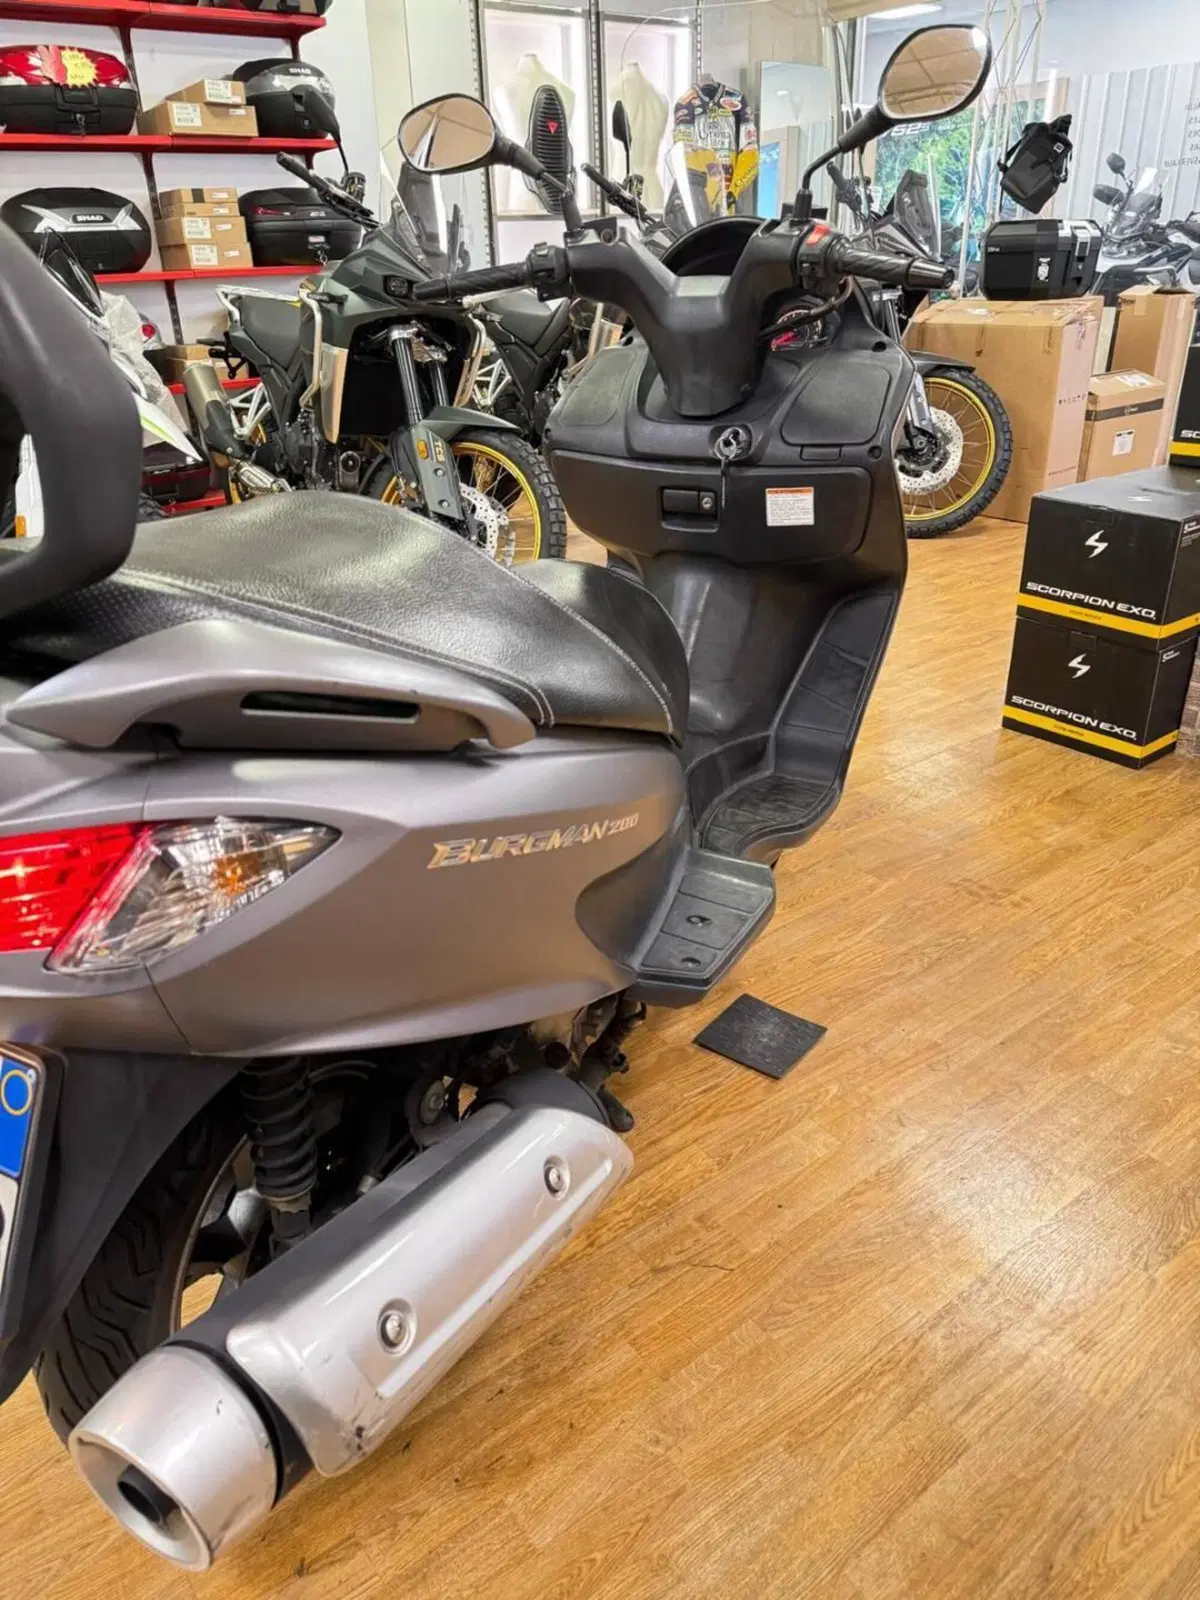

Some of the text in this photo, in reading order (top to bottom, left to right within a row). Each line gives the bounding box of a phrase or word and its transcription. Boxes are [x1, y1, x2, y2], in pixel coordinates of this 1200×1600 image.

[76, 214, 104, 222] SHAD
[1026, 581, 1115, 609] SCORPION
[1116, 603, 1157, 618] EXO
[1011, 695, 1098, 727] SCORPION
[1099, 722, 1137, 739] EXO
[427, 812, 639, 869] BURGMAN 200
